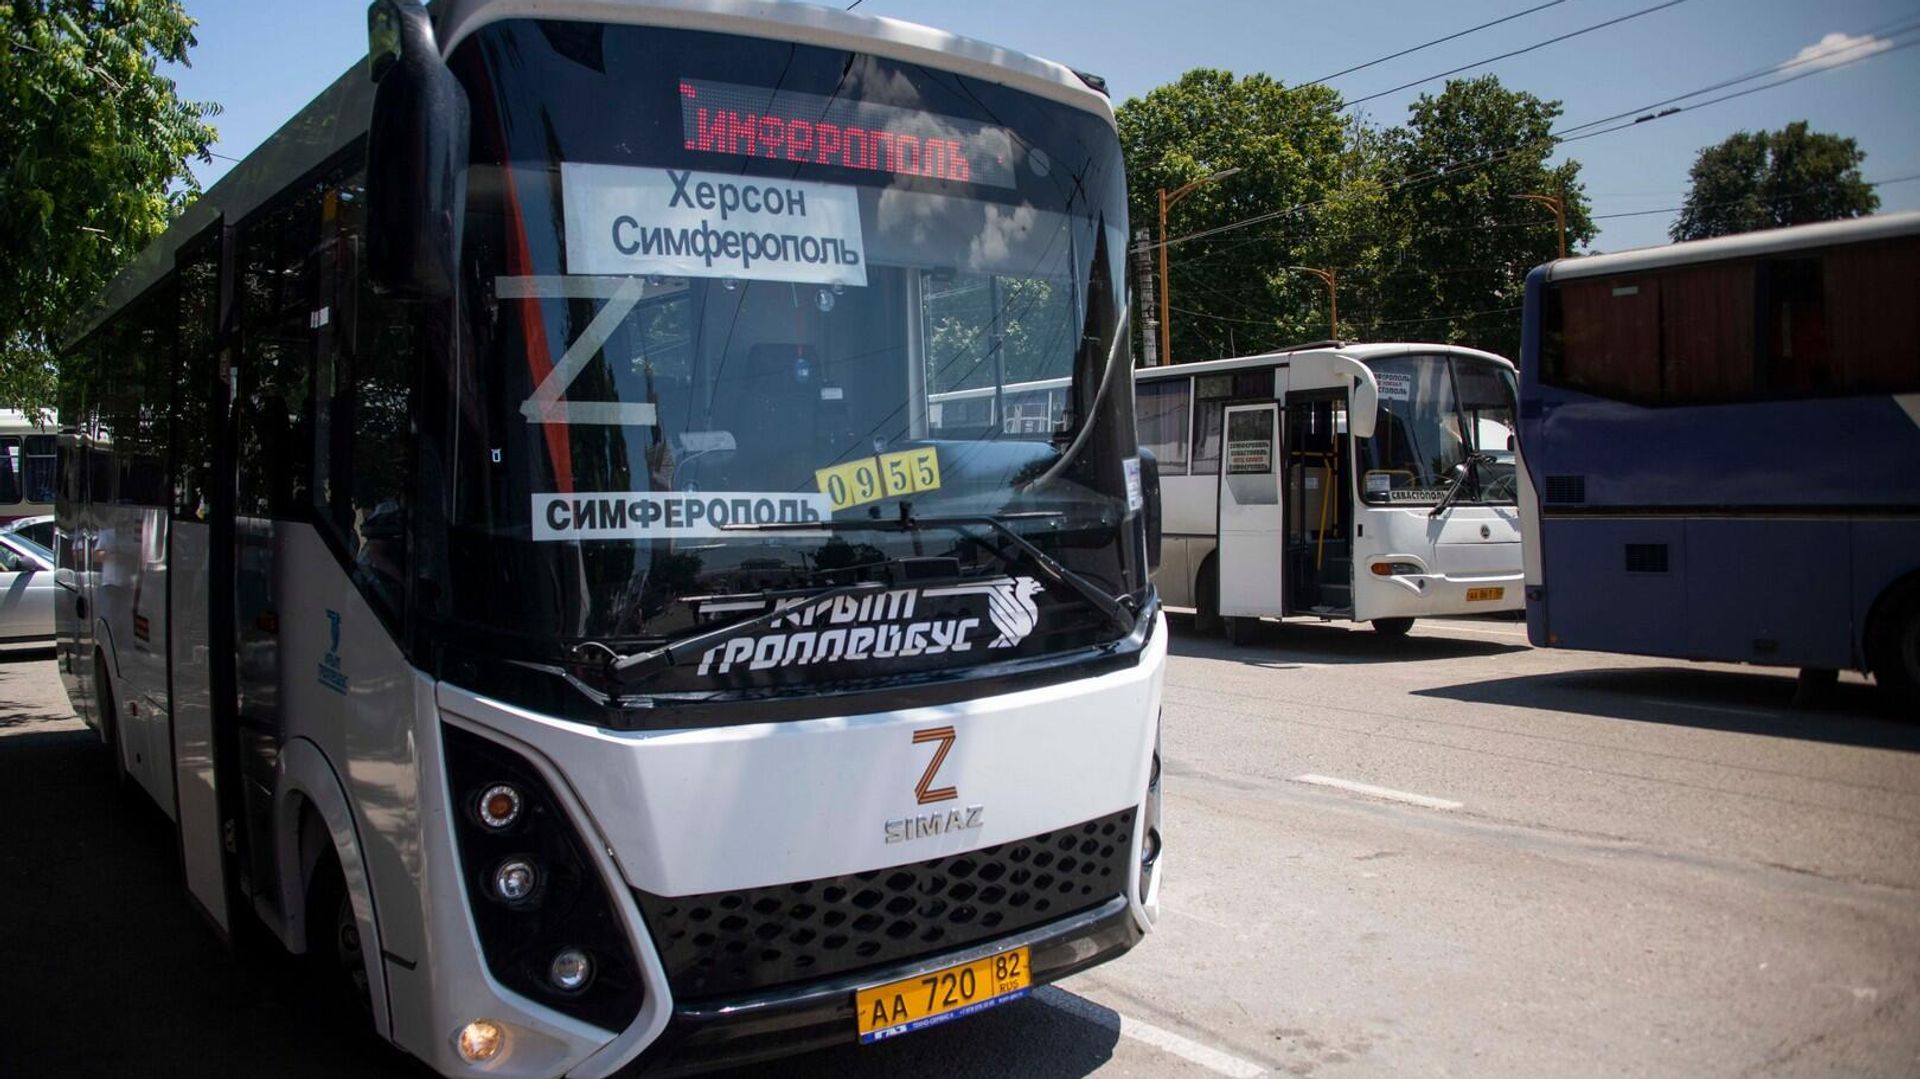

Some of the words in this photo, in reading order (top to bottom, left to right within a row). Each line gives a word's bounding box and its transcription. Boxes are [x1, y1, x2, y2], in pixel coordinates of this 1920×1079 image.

[684, 107, 970, 182] ИМФЕРОПОЛЬ
[666, 169, 807, 219] Херсон
[611, 215, 860, 269] Симферополь
[546, 498, 821, 530] СИМФЕРОПОЛЬ
[884, 804, 985, 843] SIMAZ
[921, 966, 976, 1012] 720
[995, 951, 1021, 981] 82
[999, 980, 1019, 993] RUS
